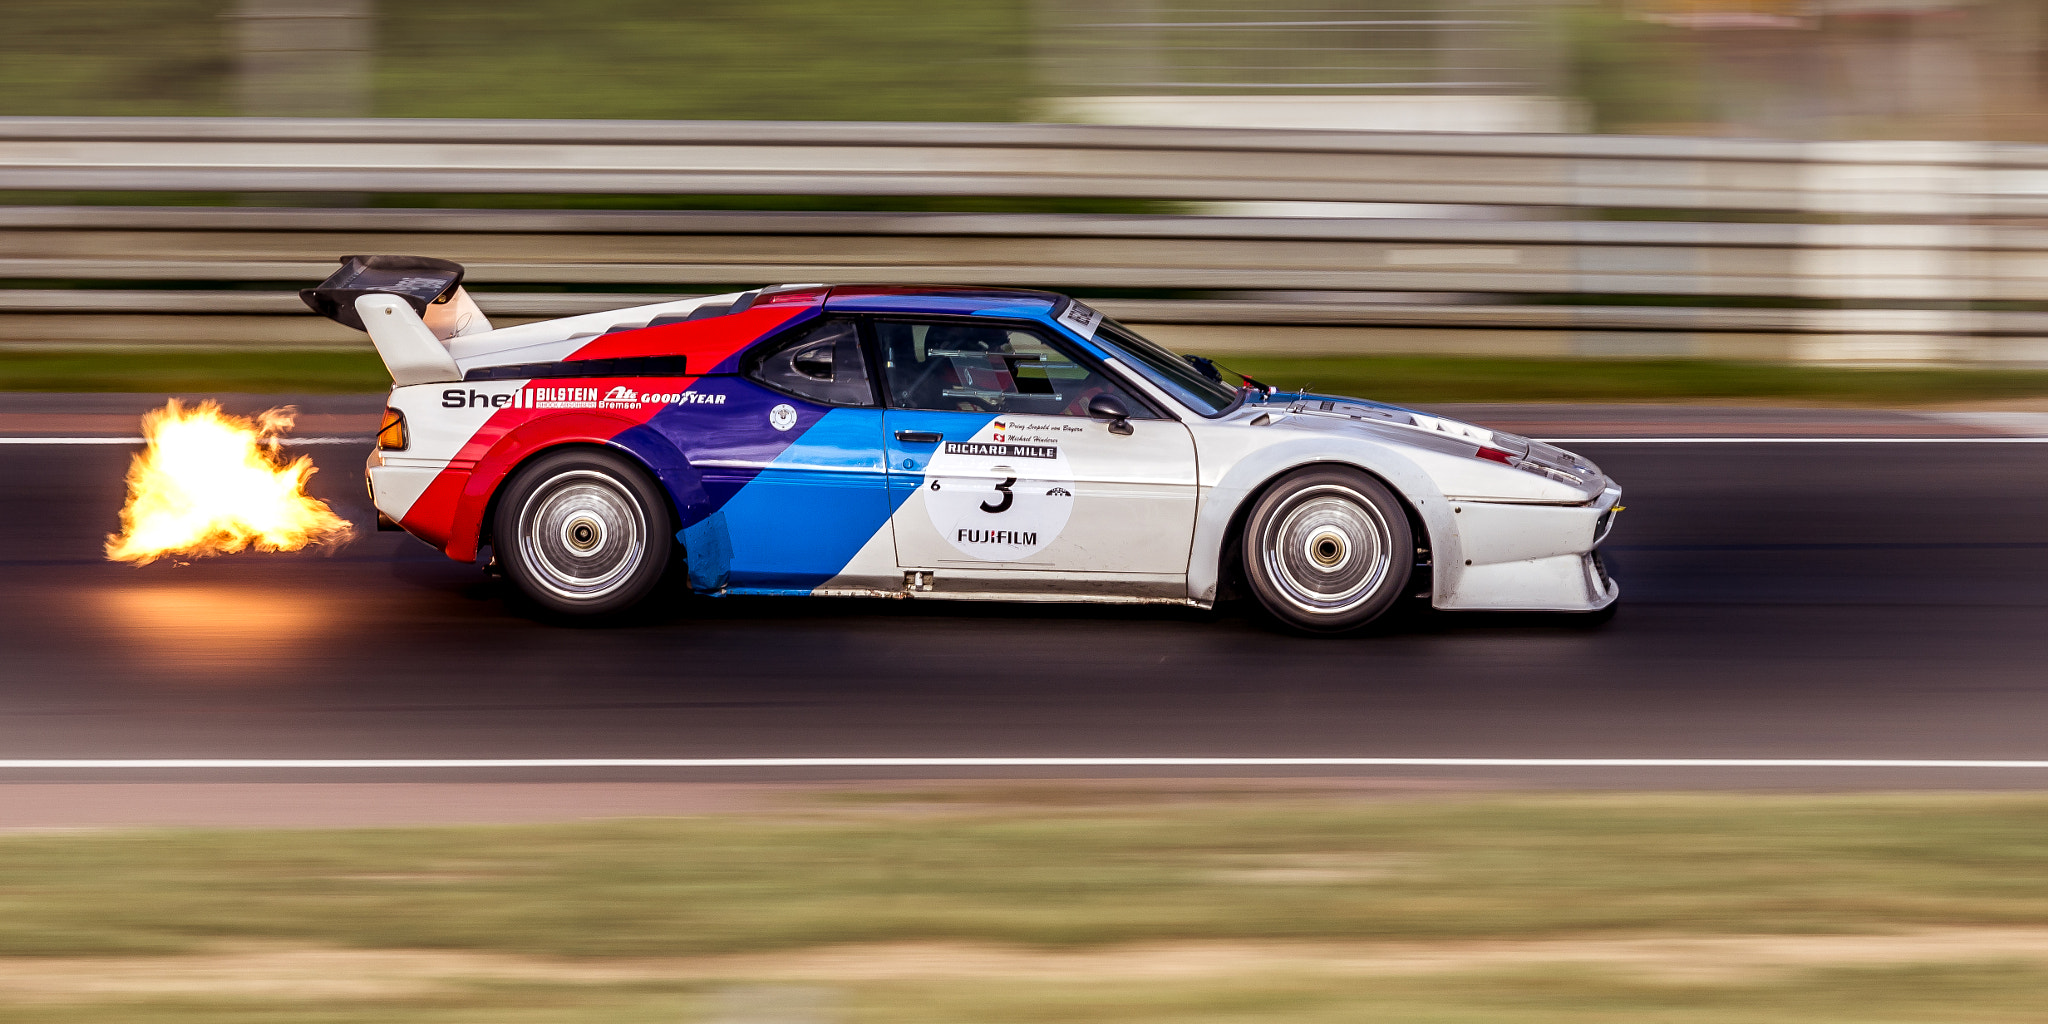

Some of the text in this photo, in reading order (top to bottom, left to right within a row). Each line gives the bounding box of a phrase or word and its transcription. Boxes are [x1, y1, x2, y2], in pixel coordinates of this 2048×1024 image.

[441, 388, 534, 409] Shell
[536, 387, 598, 401] BILSTEIN
[598, 401, 642, 409] Bremsen
[1026, 423, 1050, 431] Leopold
[1062, 424, 1084, 433] Bayern
[1007, 434, 1032, 442] Michael
[947, 443, 1055, 458] RICHARD MILLE
[930, 479, 942, 491] 6
[979, 466, 1018, 514] 3
[957, 528, 1038, 546] FUJIFILM
